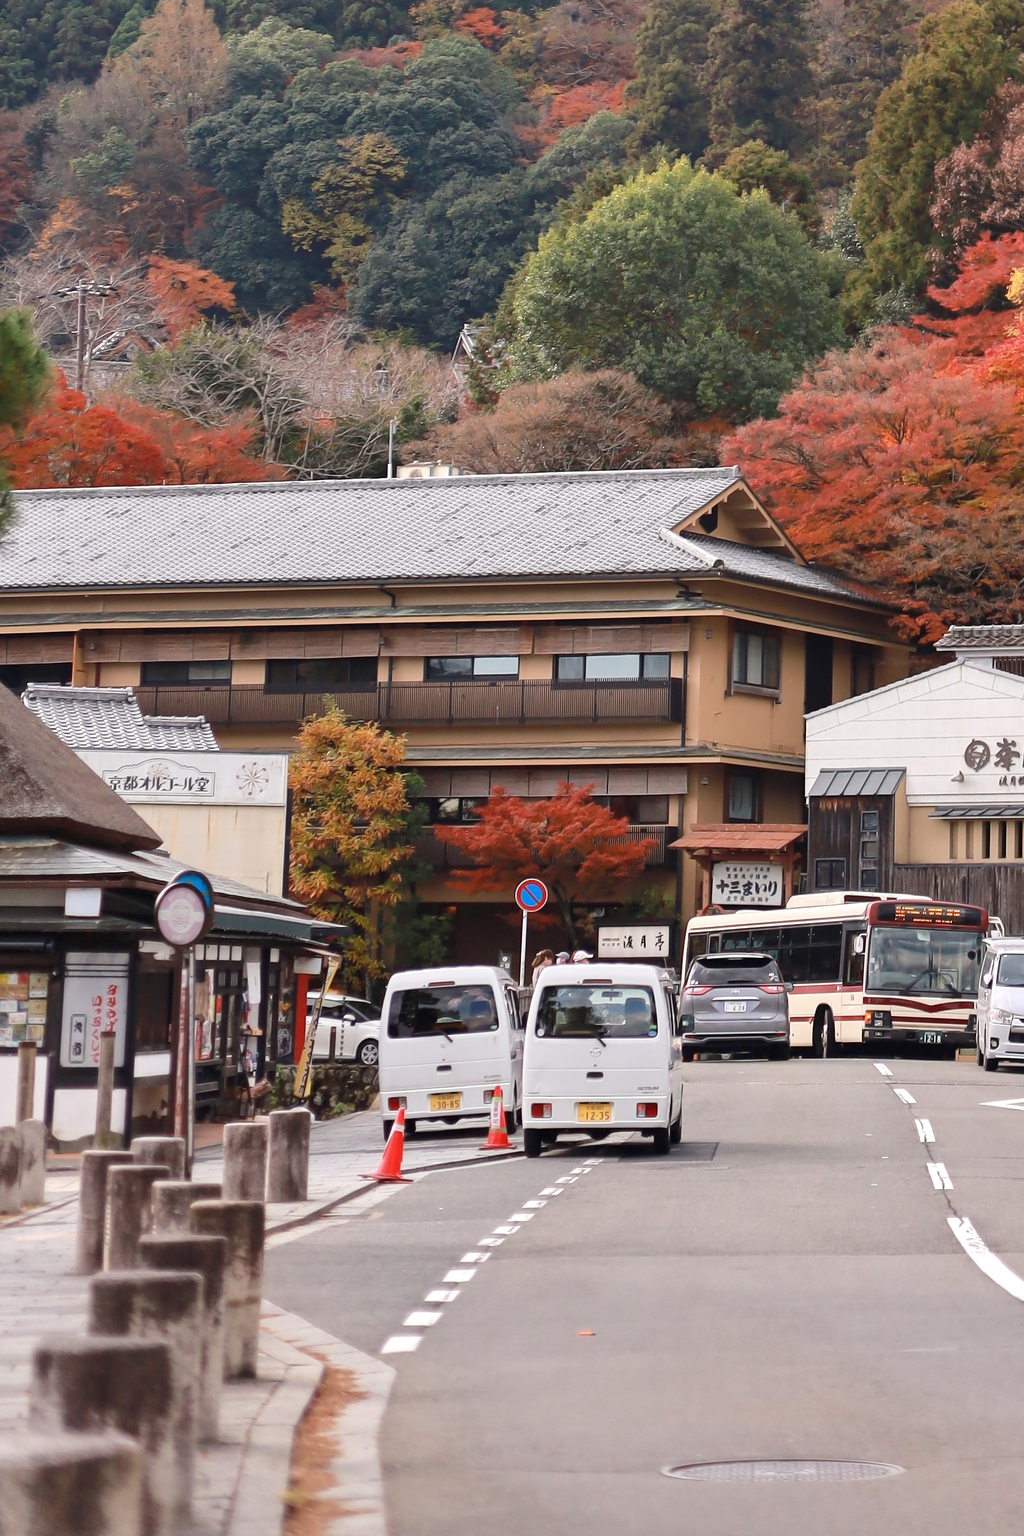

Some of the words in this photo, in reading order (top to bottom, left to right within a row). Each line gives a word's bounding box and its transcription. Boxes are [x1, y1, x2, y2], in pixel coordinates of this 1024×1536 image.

[108, 776, 210, 792] 京都オルゴール堂
[716, 880, 778, 896] 十三まいり
[623, 932, 664, 952] 渡月亭
[586, 1111, 610, 1121] 12-35
